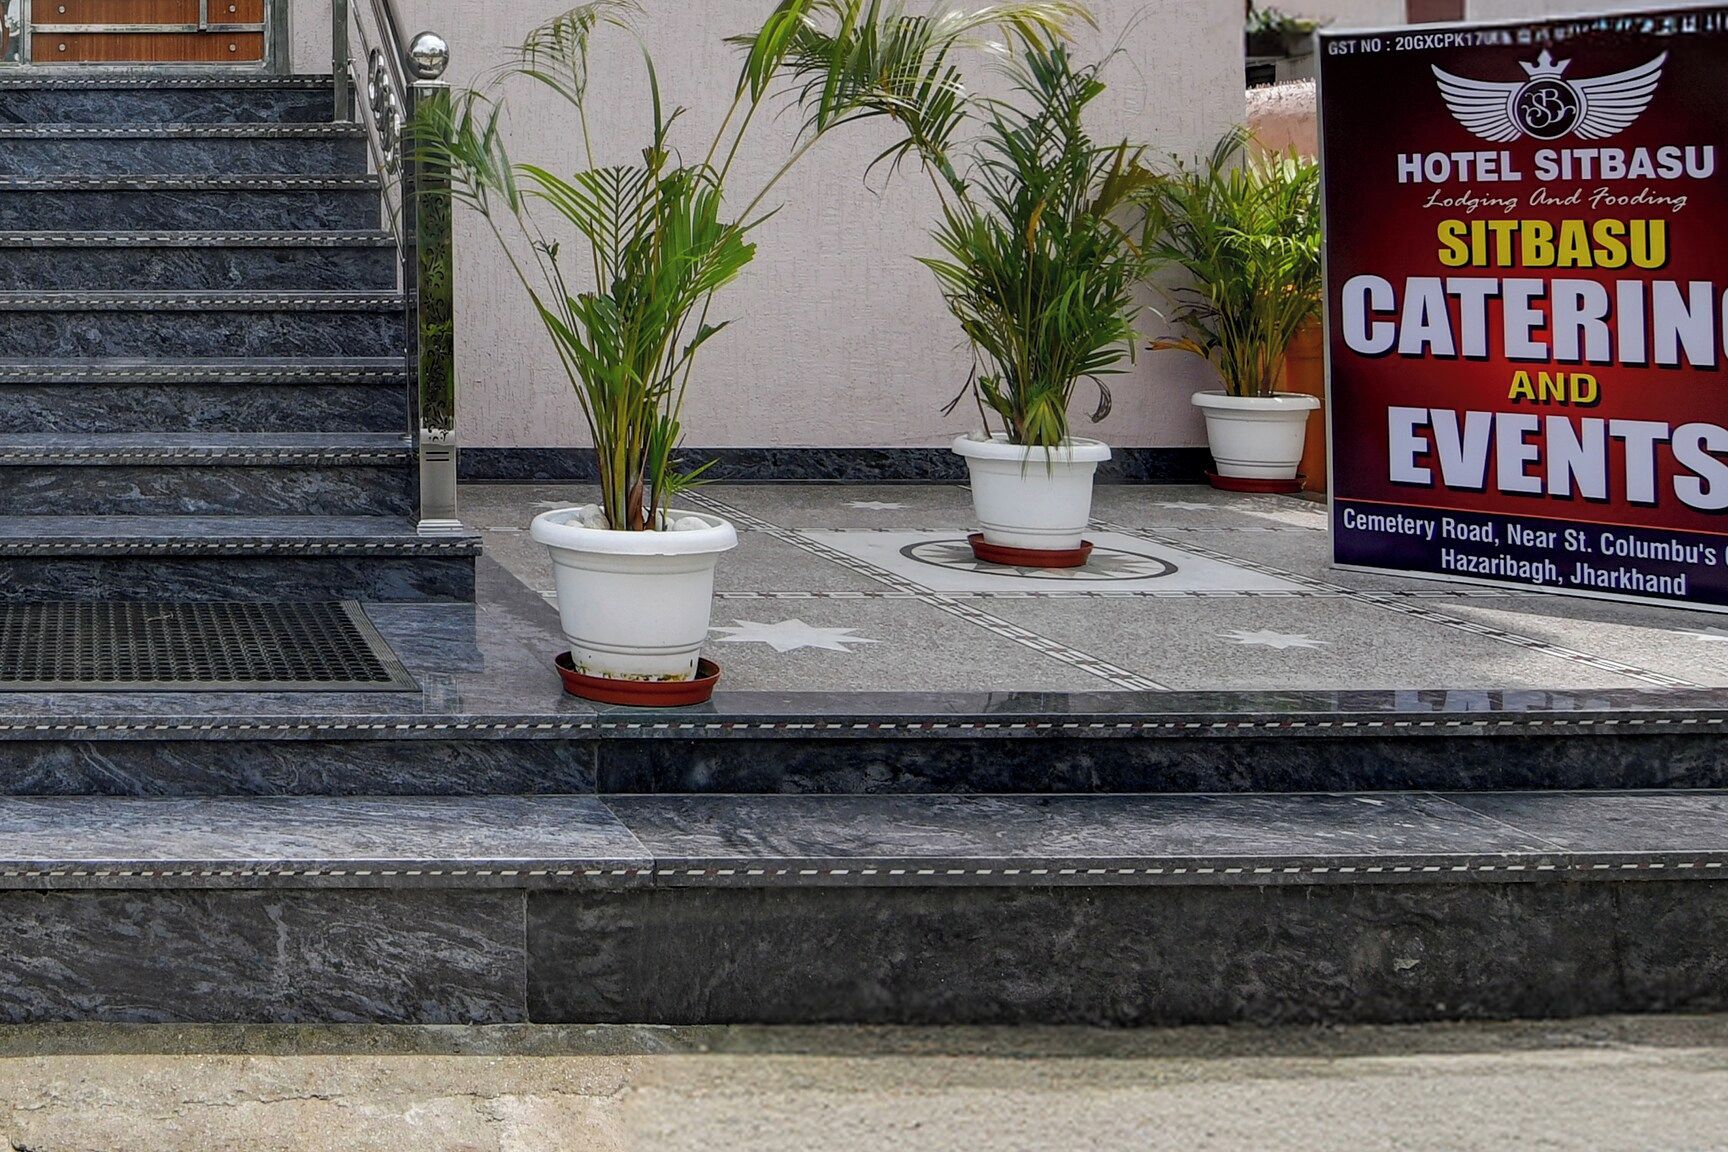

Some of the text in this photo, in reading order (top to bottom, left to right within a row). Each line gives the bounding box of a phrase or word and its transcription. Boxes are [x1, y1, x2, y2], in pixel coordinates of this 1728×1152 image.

[1328, 40, 1357, 55] GST
[1360, 38, 1381, 53] NO
[1398, 146, 1714, 183] HOTEL SITBASU
[1422, 187, 1688, 214] Lodging And Fooding
[1437, 219, 1665, 269] SITBASU
[1342, 275, 1728, 366] CATERIN
[1508, 371, 1598, 403] AND
[1388, 406, 1728, 510] EVENTS
[1343, 508, 1435, 540] Cemetery
[1442, 518, 1499, 547] Road,
[1507, 523, 1557, 549] Near
[1564, 529, 1592, 552] St.
[1600, 533, 1717, 566] Columbu's
[1441, 548, 1687, 596] Hazaribagh, Jharkhand
